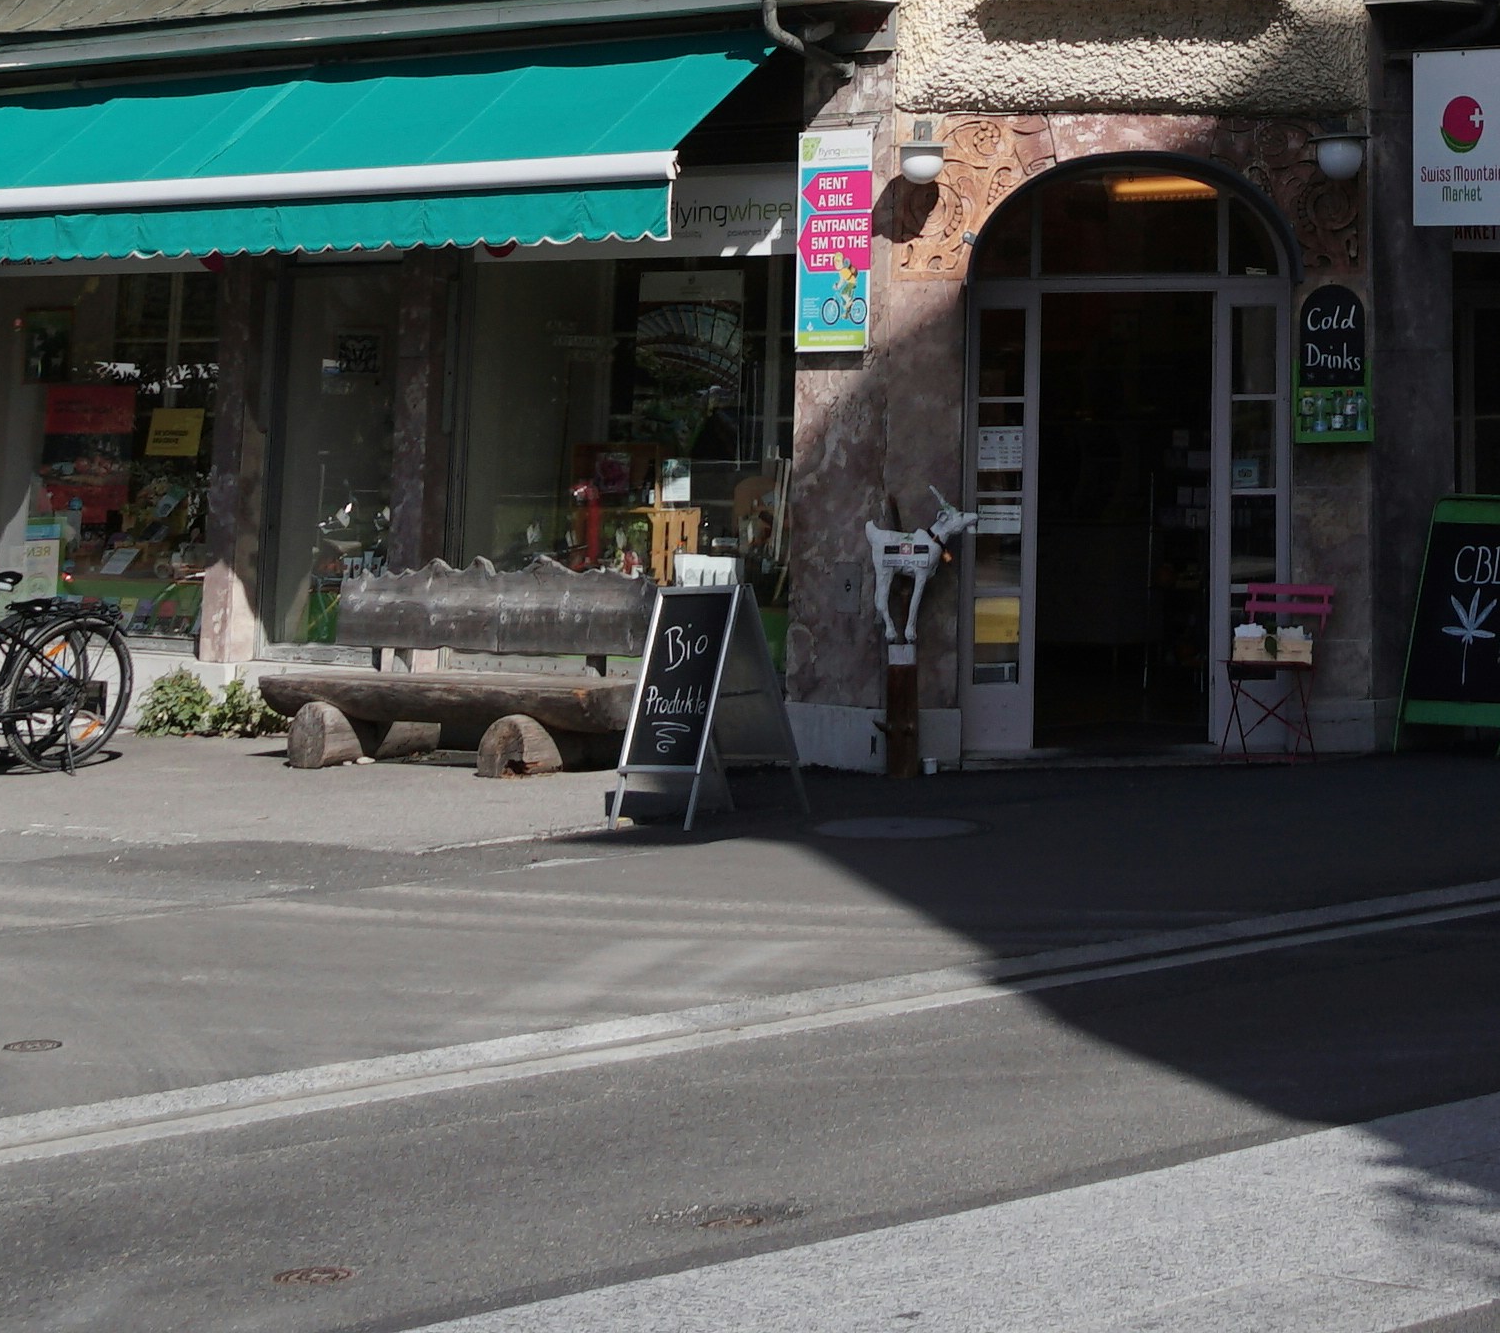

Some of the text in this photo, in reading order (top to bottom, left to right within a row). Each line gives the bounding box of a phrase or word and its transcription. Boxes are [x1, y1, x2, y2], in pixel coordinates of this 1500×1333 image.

[1420, 166, 1451, 183] Swiss
[818, 176, 849, 191] RENT
[817, 193, 854, 208] A BIKE
[1442, 184, 1483, 202] Market
[811, 218, 869, 233] ENTRANCE
[811, 235, 869, 250] 5M TO THE
[810, 253, 835, 267] LEFT
[1307, 304, 1356, 332] Cold
[1304, 342, 1361, 372] Drinks
[664, 622, 709, 673] Bio
[646, 685, 707, 716] Produkte
